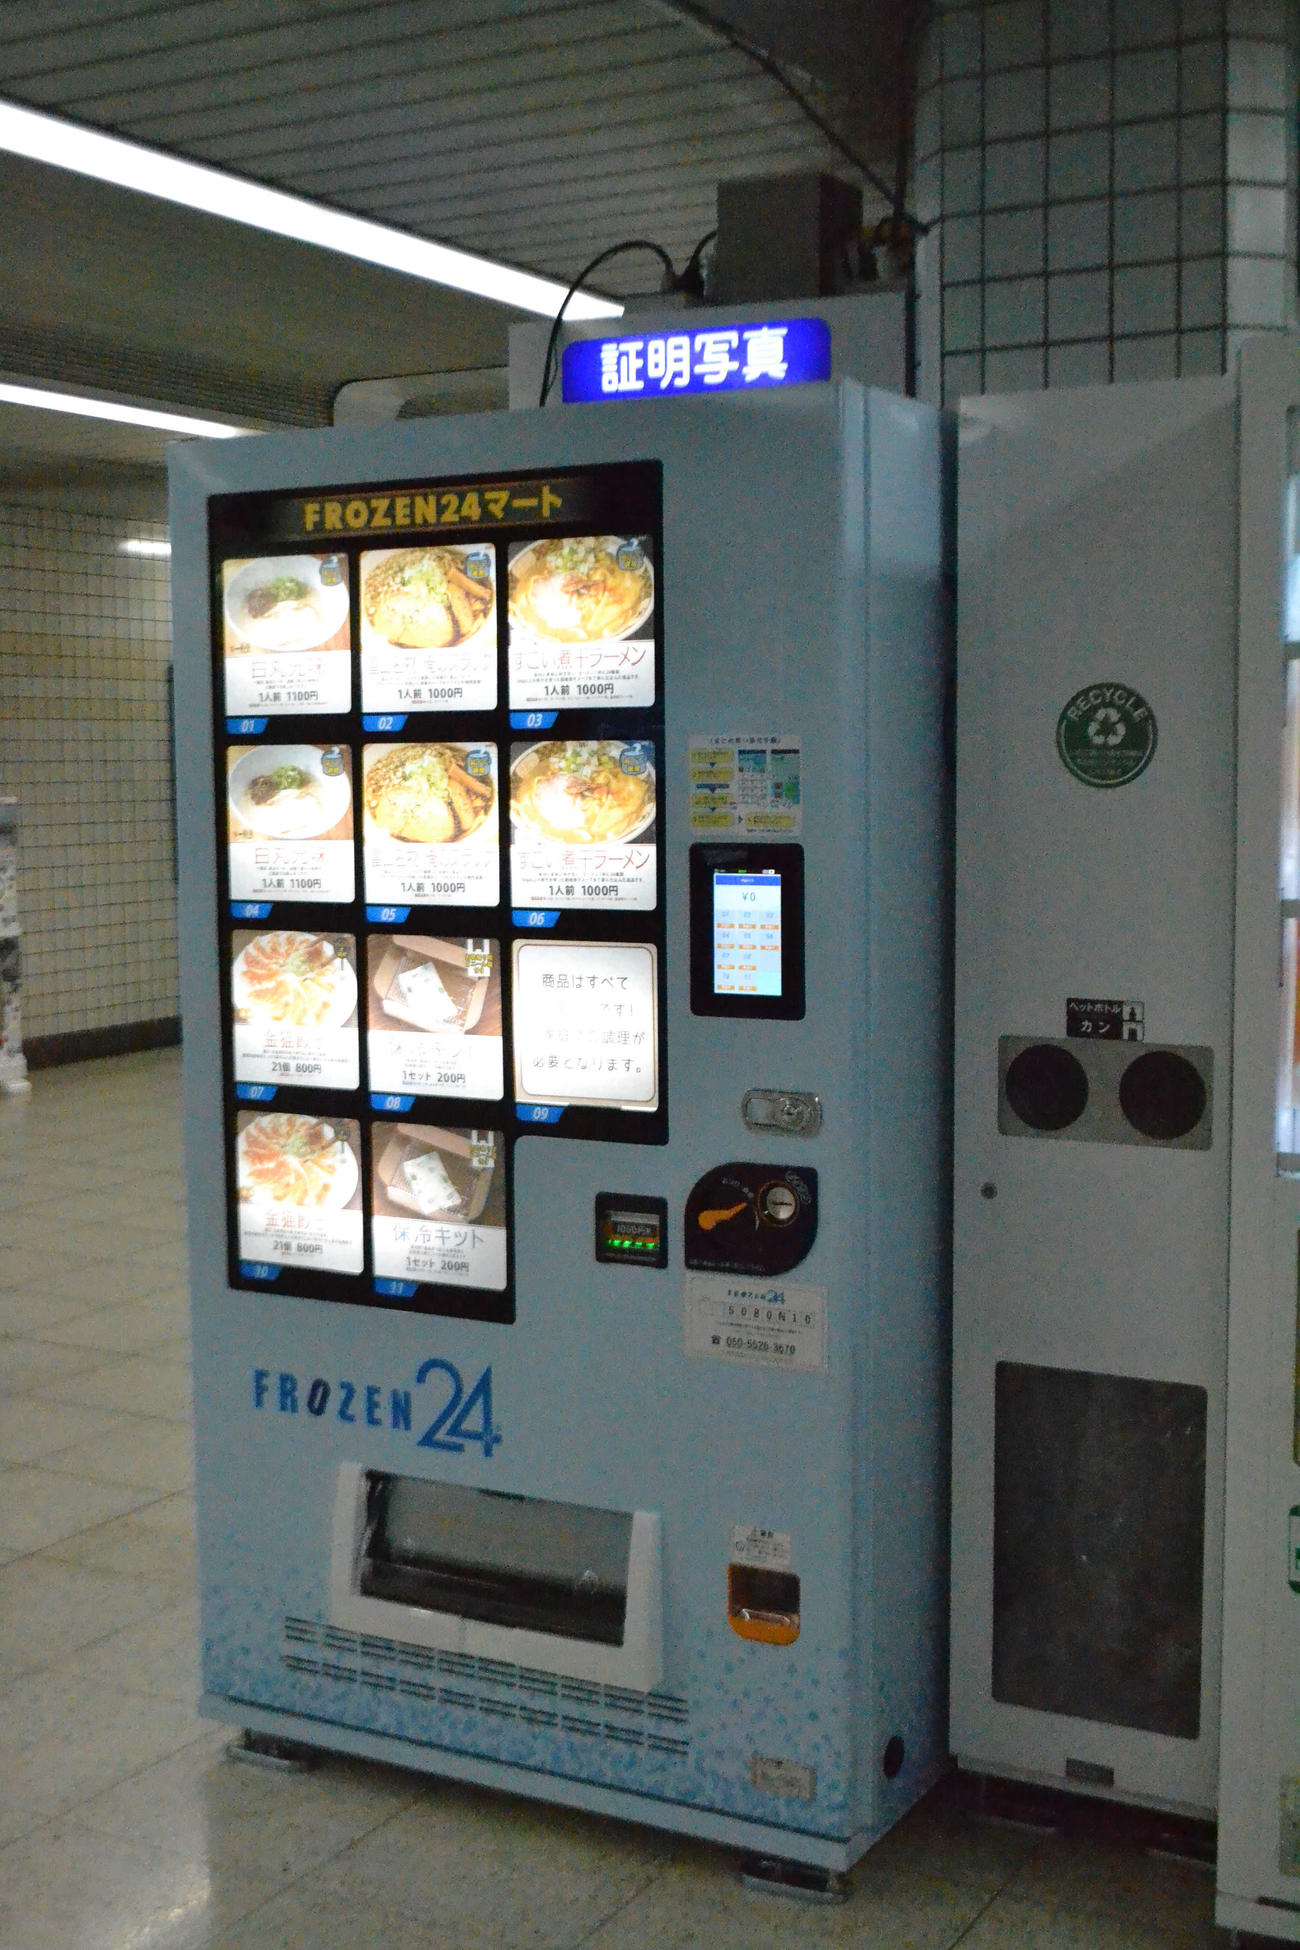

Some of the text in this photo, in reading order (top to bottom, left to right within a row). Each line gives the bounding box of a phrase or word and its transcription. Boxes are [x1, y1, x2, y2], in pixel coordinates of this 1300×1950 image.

[600, 327, 788, 393] 証明写真
[303, 485, 563, 532] FROZEN24マート
[287, 690, 319, 702] 1100円
[397, 687, 463, 699] 1人前 1000円
[544, 683, 614, 696] 1人前 1000円
[1067, 687, 1148, 721] RECYCLE
[377, 717, 393, 731] 02
[526, 713, 543, 728] 03
[290, 878, 322, 889] 1100円
[400, 882, 466, 893] 1人前 1000円
[548, 885, 619, 897] 1人前 1000円
[381, 907, 396, 921] 05
[528, 911, 545, 926] 06
[541, 973, 632, 990] 商品はすべて
[1081, 1020, 1110, 1033] カン
[295, 1063, 322, 1074] 800円
[532, 1055, 642, 1074] 必要となります。
[402, 1070, 431, 1081] 1セット
[437, 1072, 466, 1084] 200円
[386, 1096, 401, 1110] 08
[532, 1106, 549, 1121] 09
[393, 1223, 485, 1249] 保冷キット
[441, 1259, 470, 1272] 200円
[253, 1358, 503, 1458] FROZEN24
